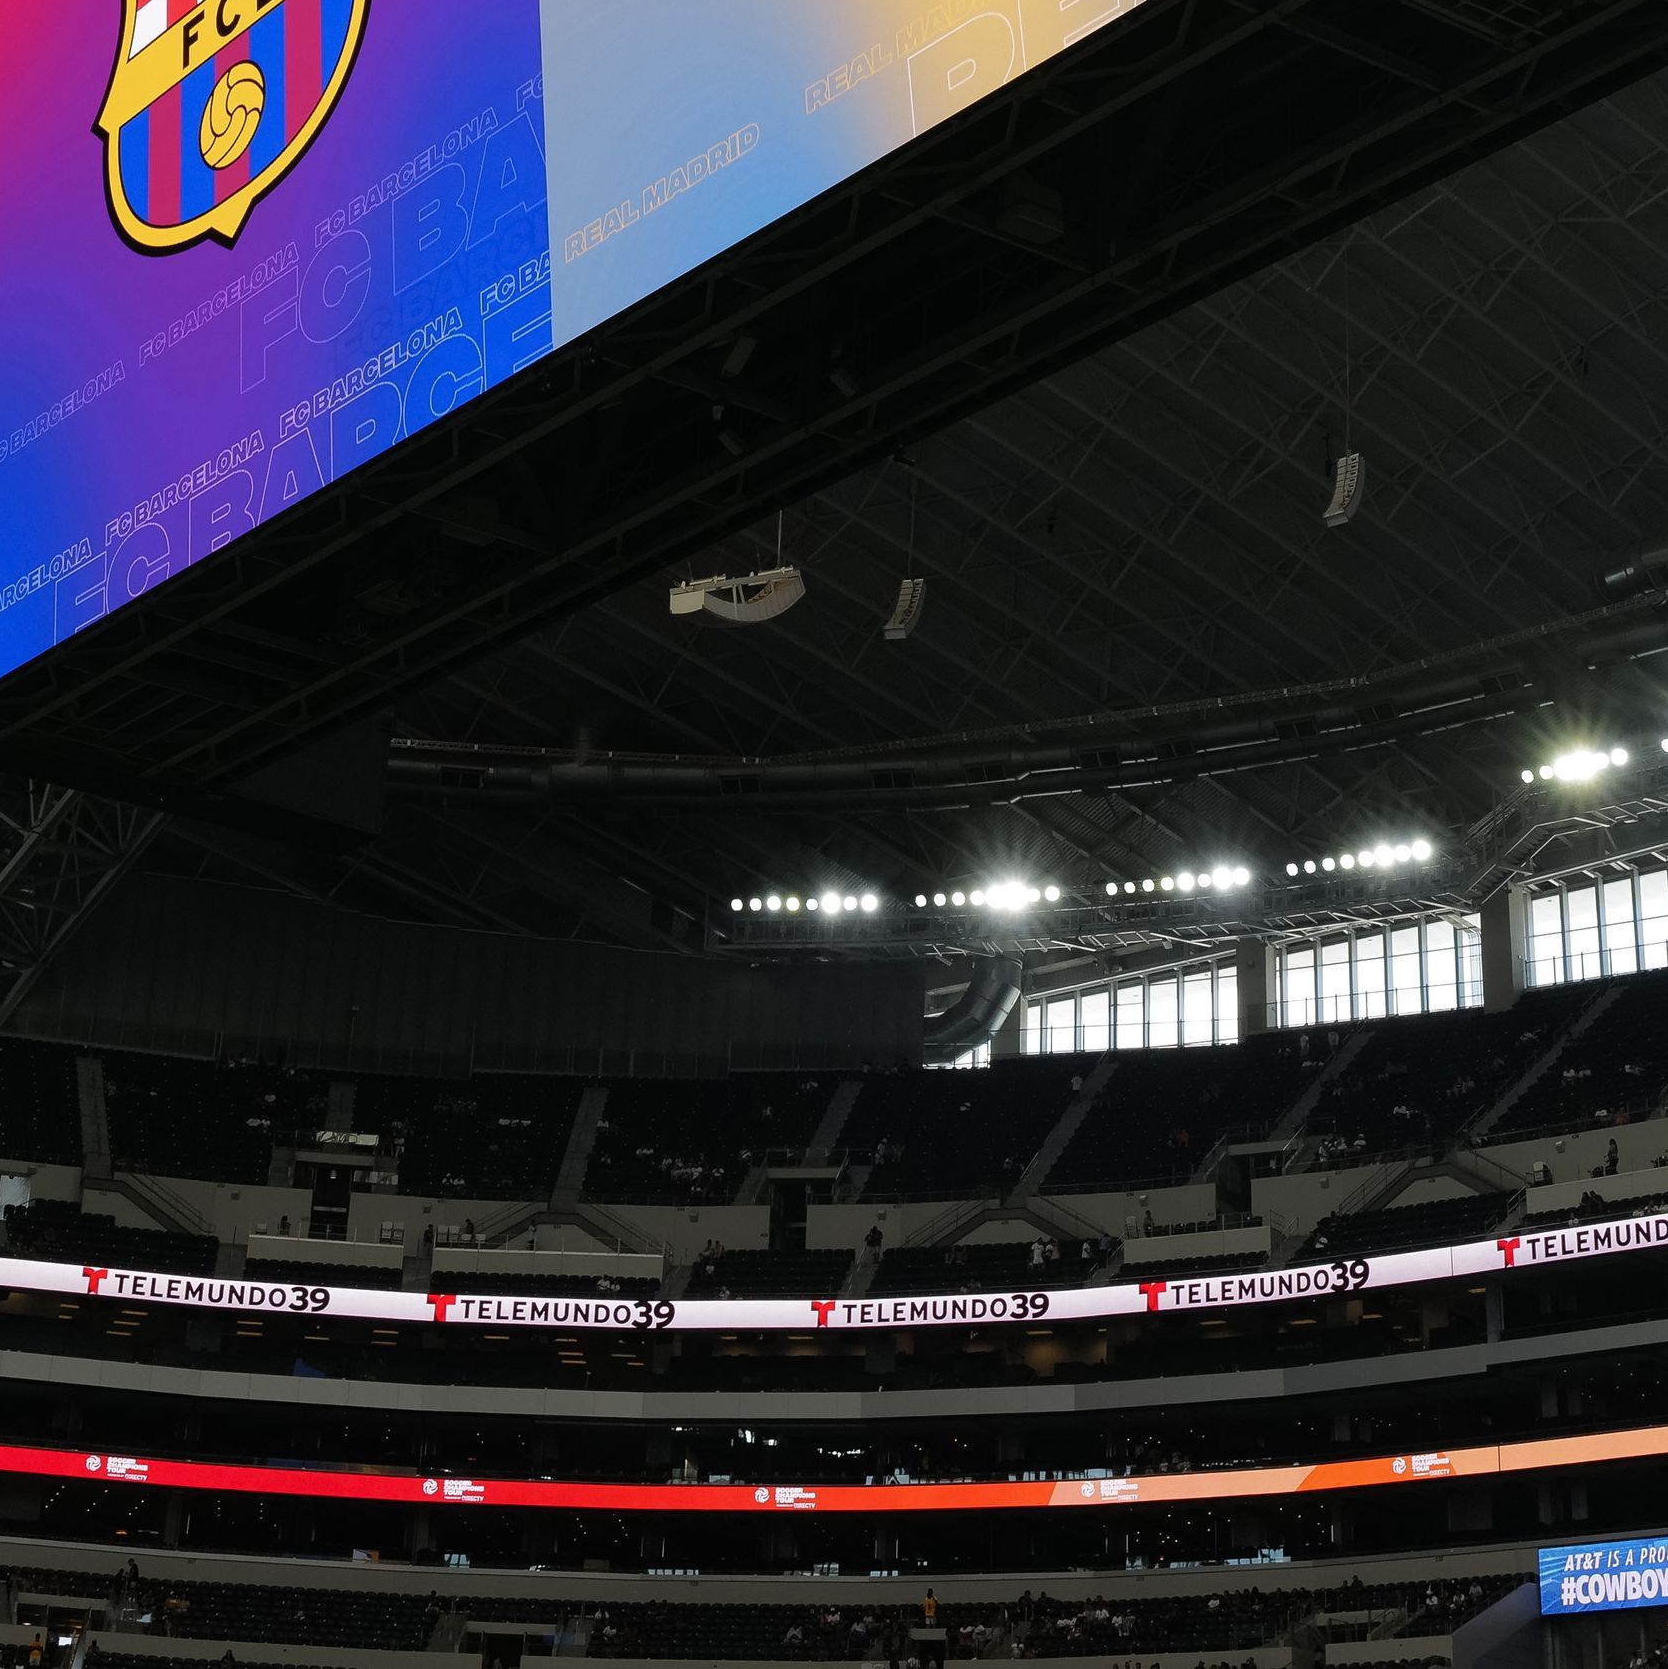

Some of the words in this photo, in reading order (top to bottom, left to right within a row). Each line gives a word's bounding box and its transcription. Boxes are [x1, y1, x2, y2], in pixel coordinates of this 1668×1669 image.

[642, 123, 760, 216] MADRID
[10, 359, 125, 463] BARCELONA
[168, 242, 300, 355] BARCELONA
[315, 209, 345, 244] FC
[348, 107, 499, 229] BARCELONA
[104, 513, 132, 545] FC
[133, 429, 264, 534] BARCELONA
[279, 400, 310, 437] FC
[313, 306, 462, 420] BARCELONA
[480, 271, 516, 316] FC
[1564, 1551, 1603, 1572] AT&T
[1607, 1550, 1620, 1567] IS
[1625, 1549, 1634, 1565] A
